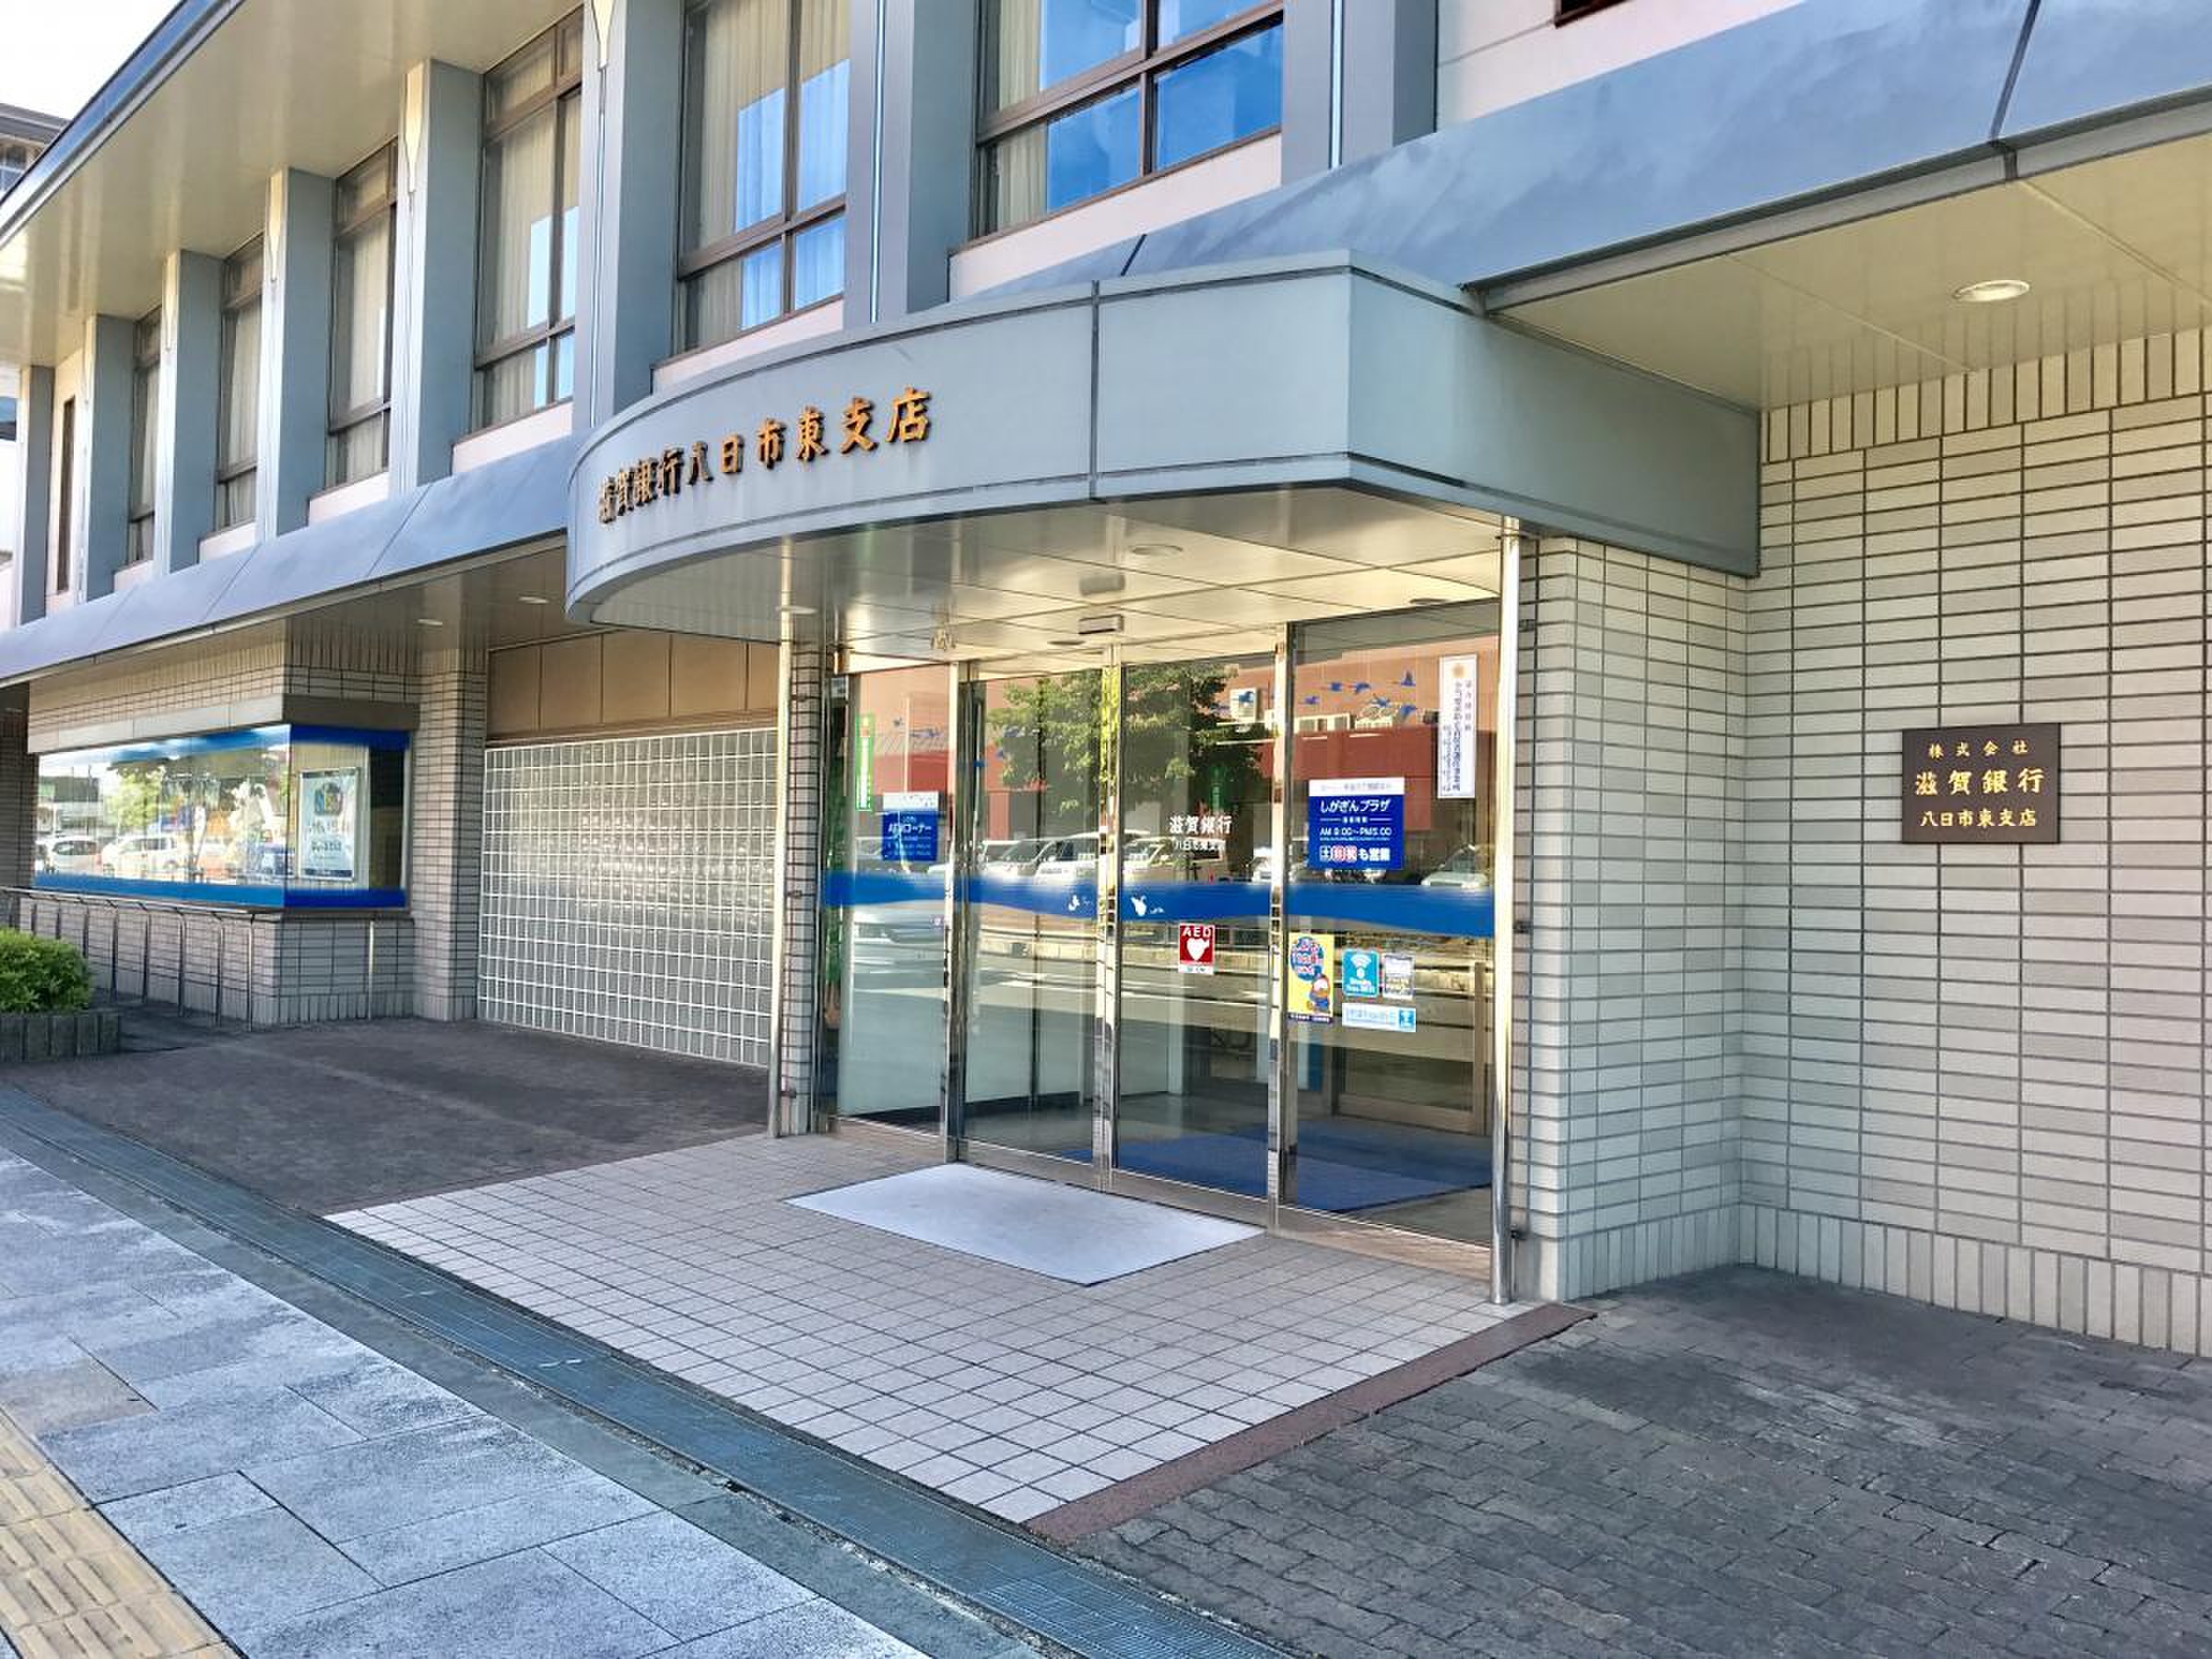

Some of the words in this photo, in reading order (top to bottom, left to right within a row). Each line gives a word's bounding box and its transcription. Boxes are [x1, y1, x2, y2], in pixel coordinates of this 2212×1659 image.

[1928, 740, 2030, 759] 株式会社
[1915, 768, 2045, 795] 滋賀銀行
[1170, 815, 1232, 834] 滋賀銀行
[1920, 808, 2036, 829] 八日市東支店
[1182, 926, 1212, 937] AED
